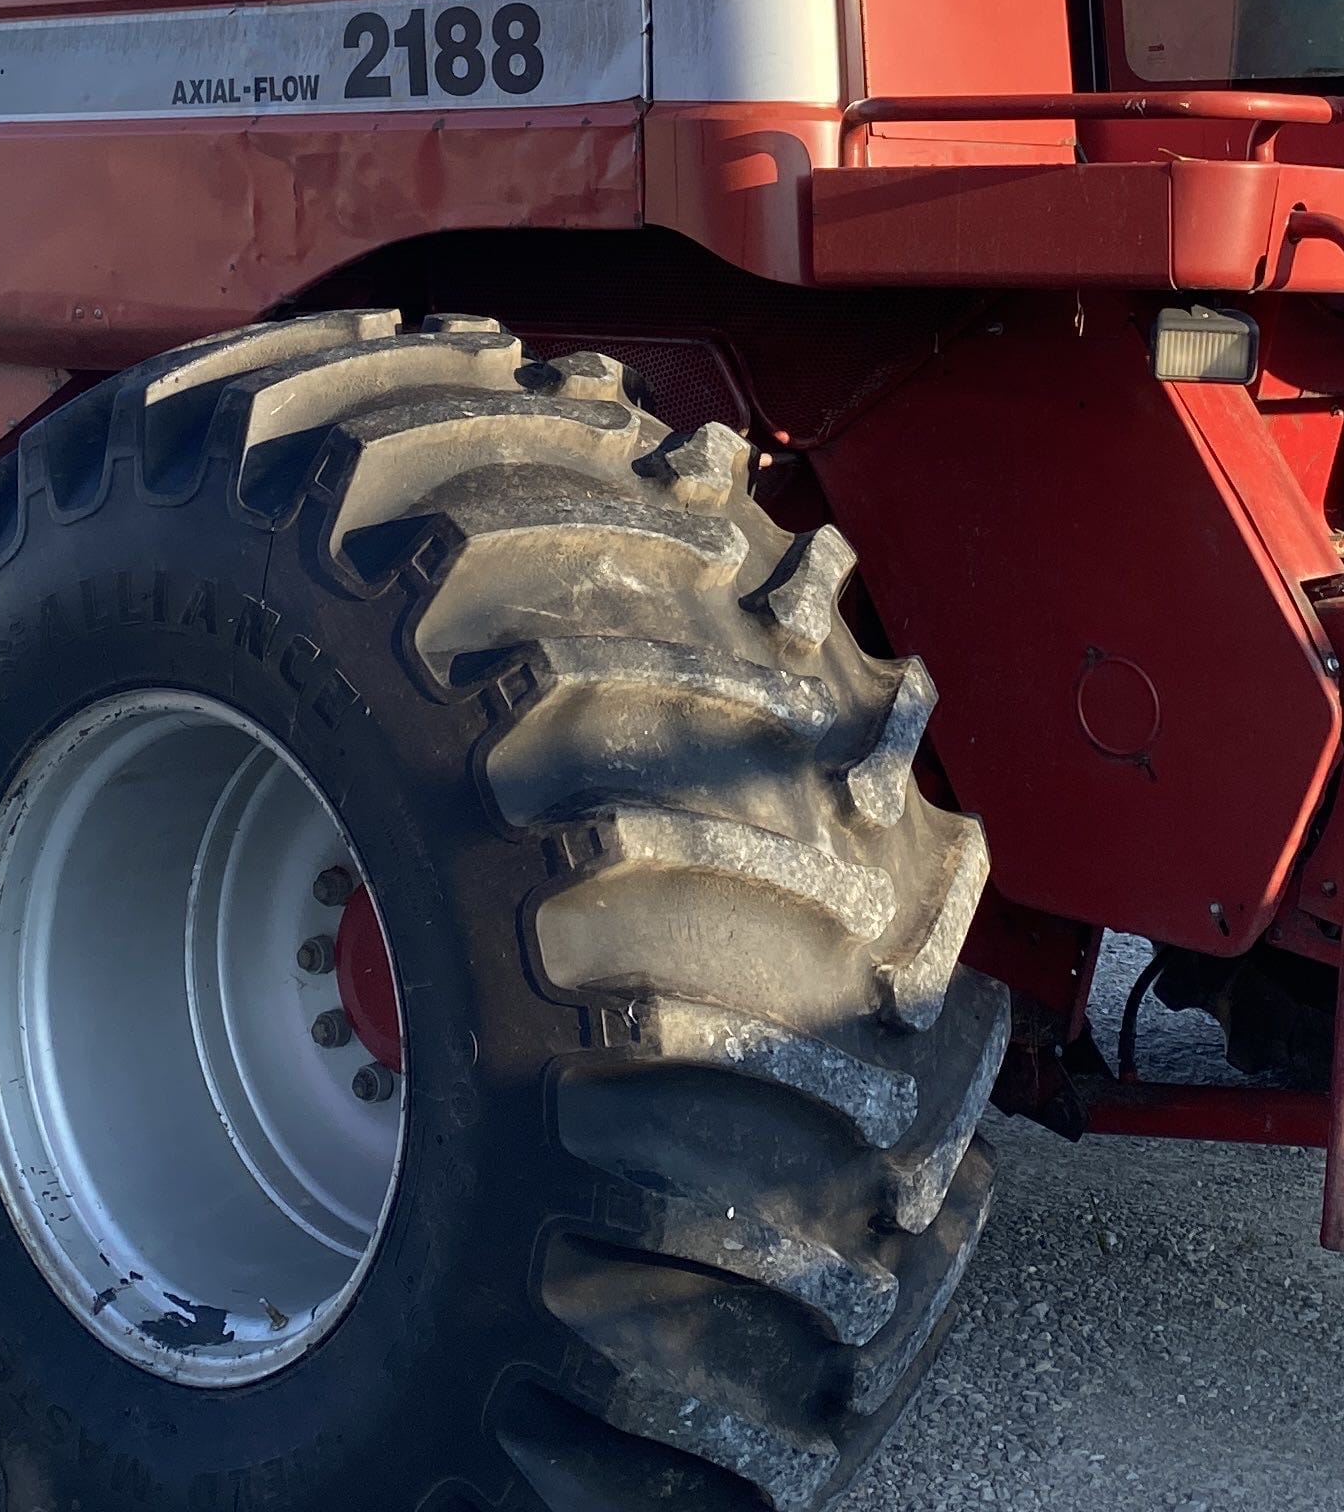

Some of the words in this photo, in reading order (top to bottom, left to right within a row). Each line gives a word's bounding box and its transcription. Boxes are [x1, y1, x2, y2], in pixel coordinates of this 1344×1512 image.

[171, 75, 320, 105] AXIAL-FLOW
[343, 2, 545, 99] 2188
[34, 567, 362, 732] ALLIANCE
